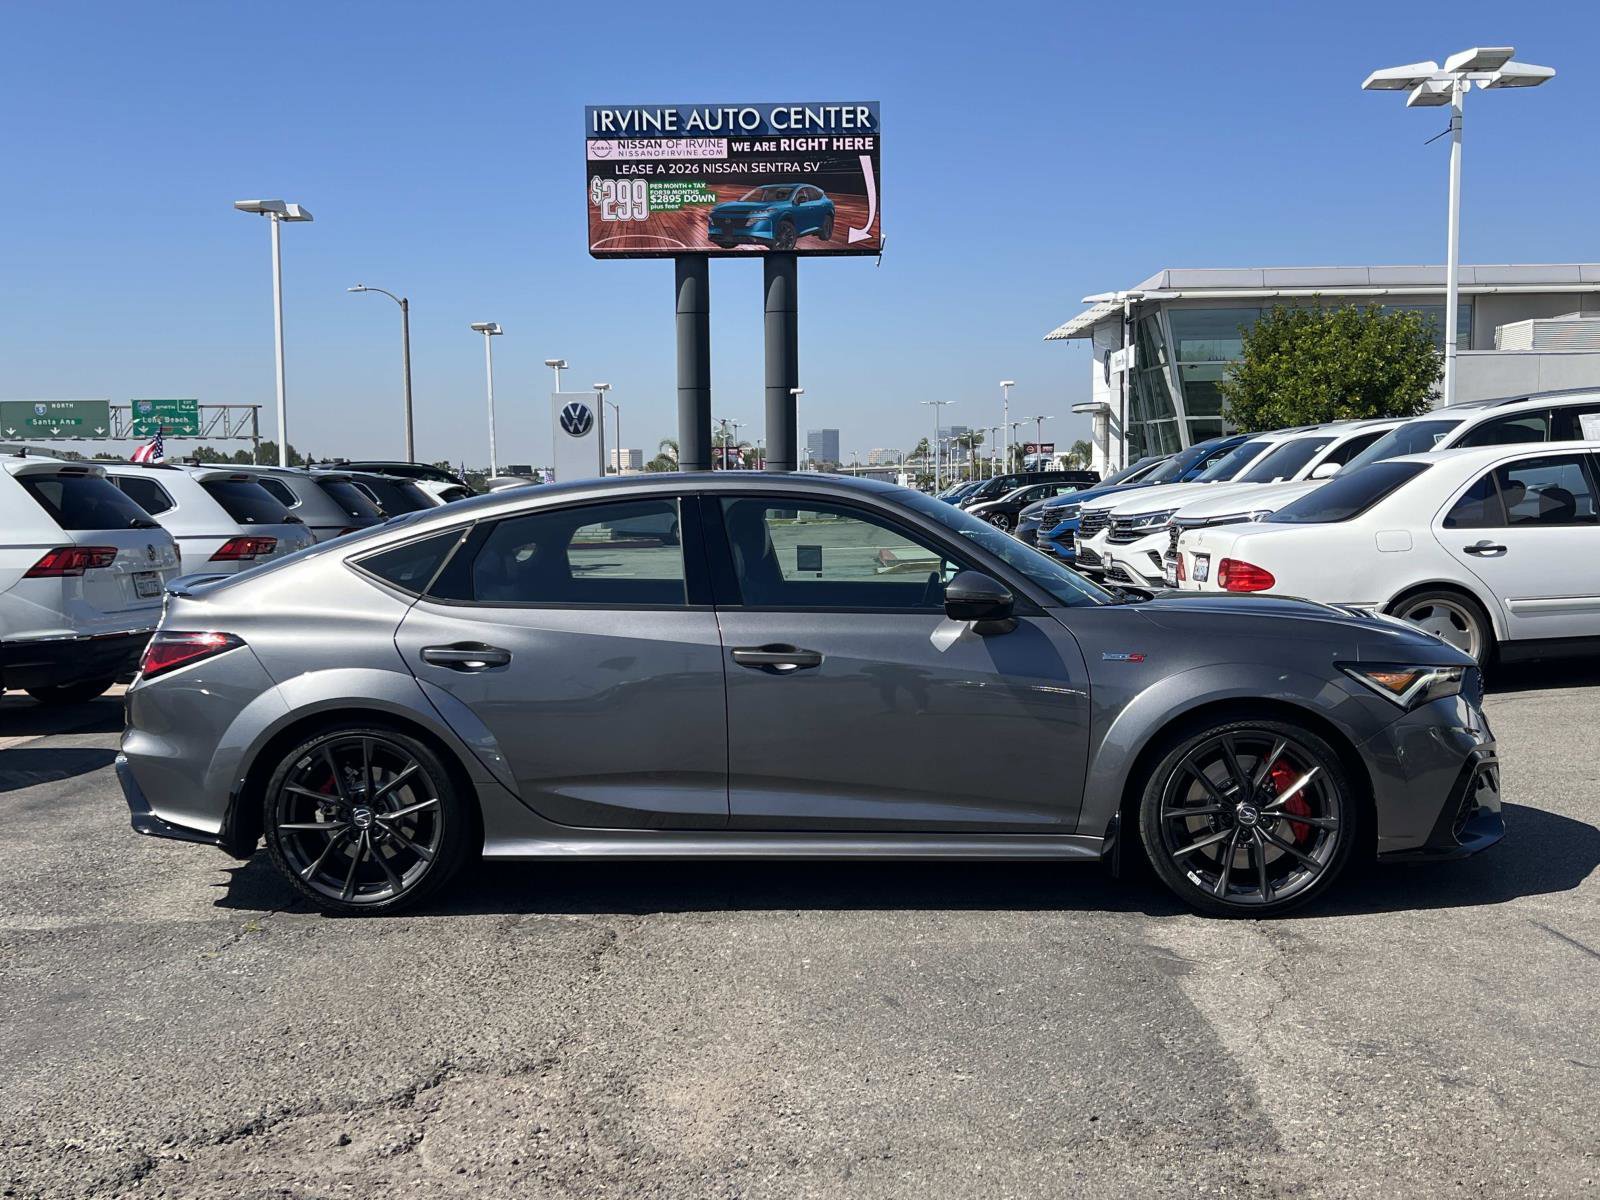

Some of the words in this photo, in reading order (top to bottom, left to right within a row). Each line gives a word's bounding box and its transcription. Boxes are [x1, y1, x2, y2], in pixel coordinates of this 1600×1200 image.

[592, 109, 678, 132] IRVINE
[686, 107, 761, 131] AUTO
[769, 106, 872, 130] CENTER
[617, 140, 662, 150] NISSAN
[666, 139, 684, 149] OF
[685, 139, 724, 149] IRVINE
[732, 142, 751, 152] WE
[753, 142, 777, 152] ARE
[780, 138, 829, 152] RIGHT
[832, 137, 874, 150] HERE
[615, 164, 654, 175] LEASE
[656, 164, 667, 174] A
[669, 164, 700, 174] 2026
[702, 163, 748, 173] NISSAN
[751, 162, 801, 173] SENTRA
[803, 162, 821, 172] SV
[591, 176, 649, 221] $299
[650, 195, 681, 203] $2895
[683, 194, 716, 203] DOWN
